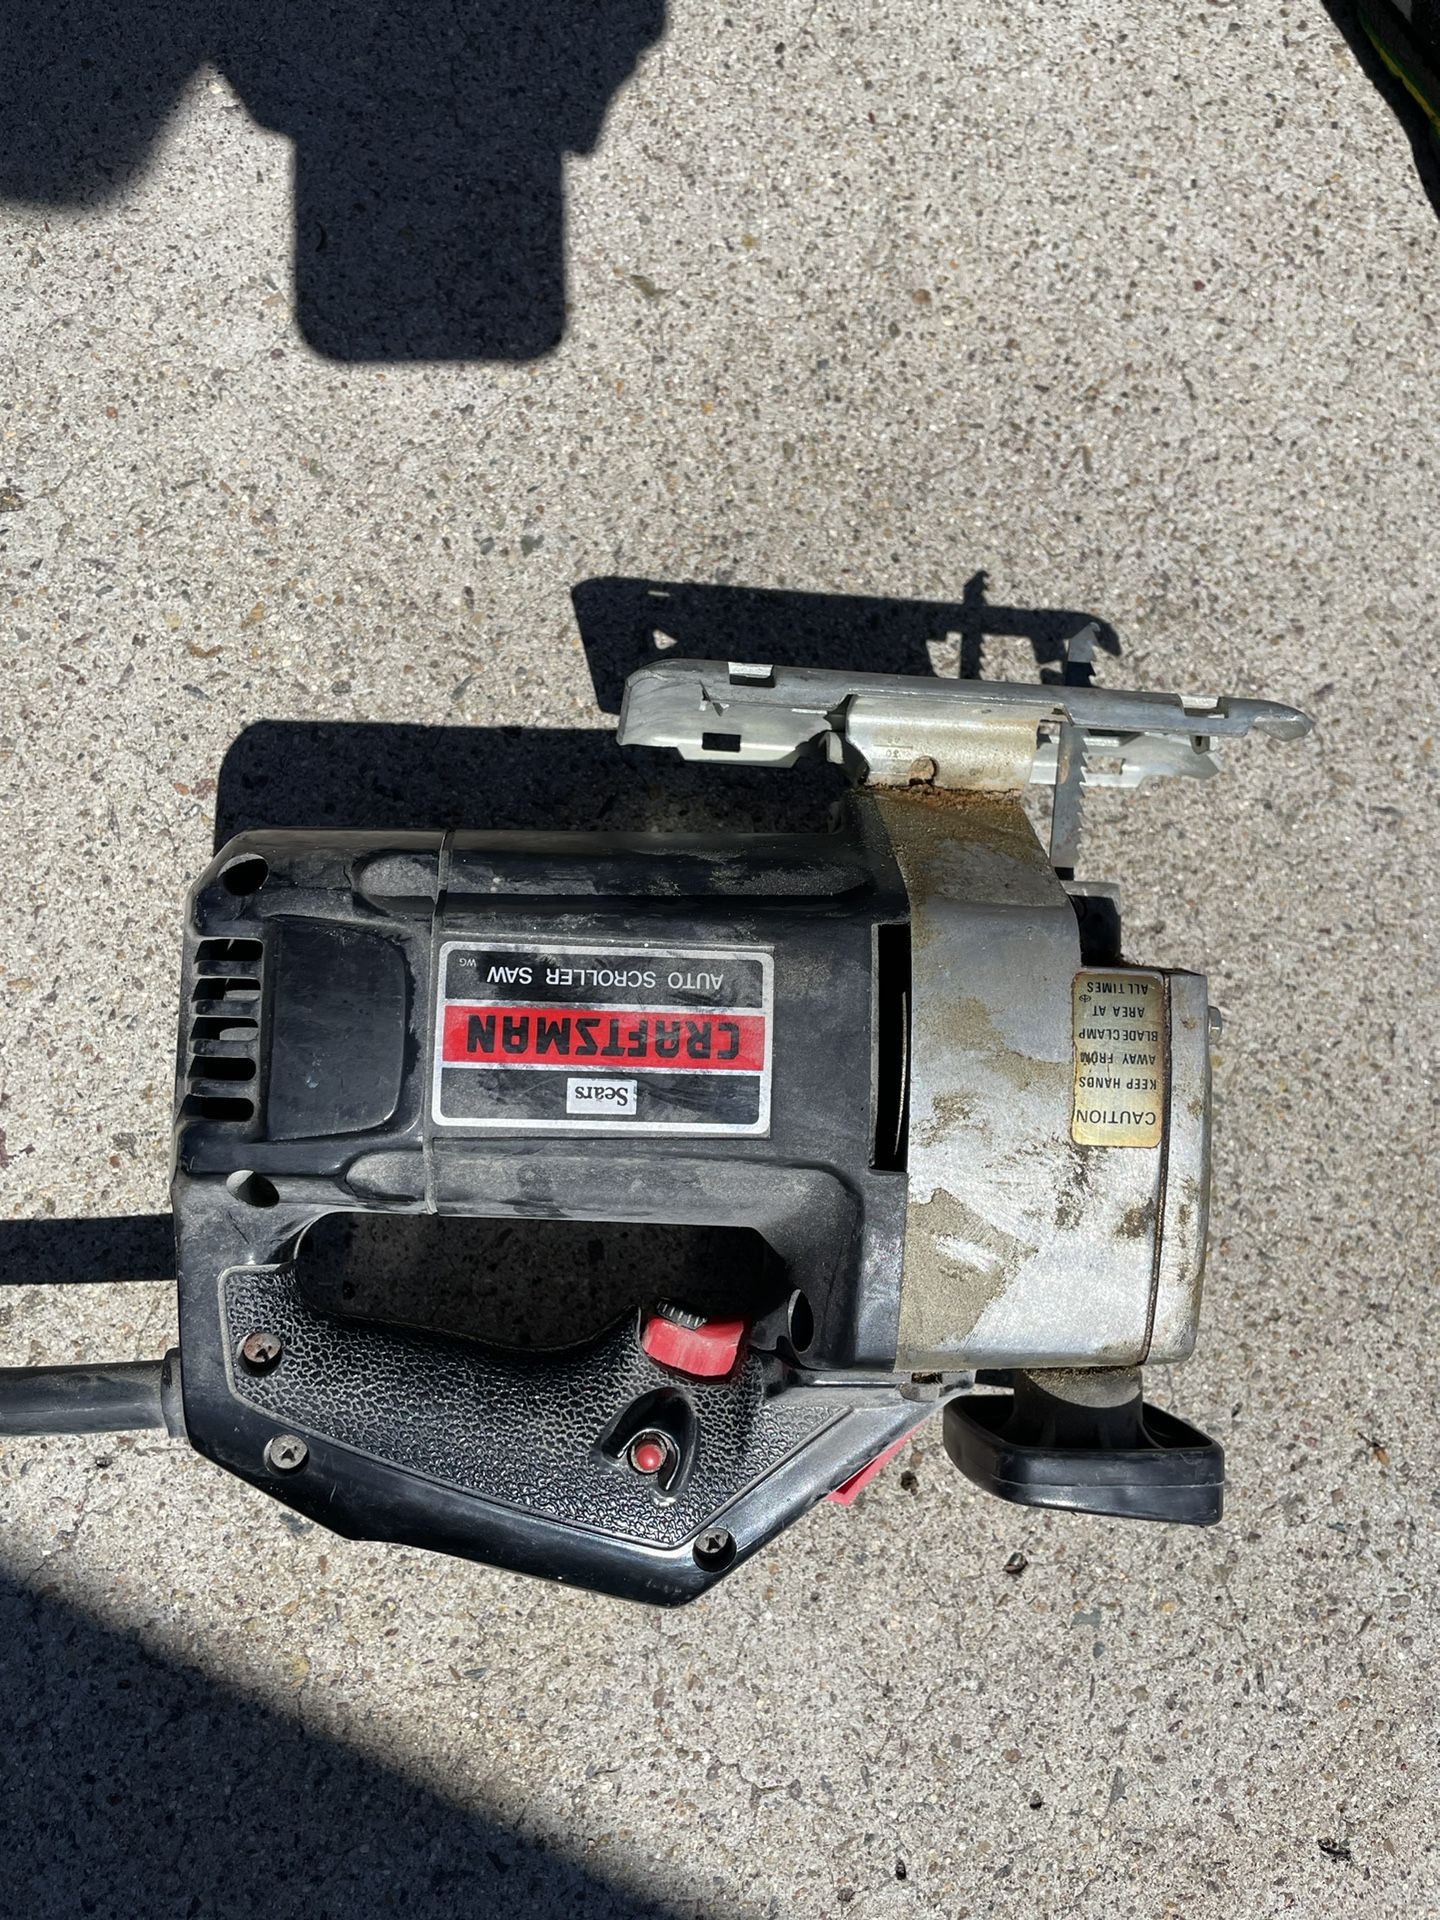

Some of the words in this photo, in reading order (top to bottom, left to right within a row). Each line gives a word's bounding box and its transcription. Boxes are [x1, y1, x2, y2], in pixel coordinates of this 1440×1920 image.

[459, 958, 476, 967] WG
[486, 966, 532, 985] SAW
[546, 968, 656, 987] SCROLLER
[668, 972, 724, 989] AUTO
[1092, 1006, 1106, 1017] AT
[1113, 1006, 1145, 1018] AREA
[467, 1014, 740, 1059] CRAFTSMAN
[1080, 1052, 1114, 1065] FROM
[1122, 1054, 1156, 1065] AWAY
[1126, 1078, 1157, 1090] KEEP
[575, 1086, 628, 1106] Sears
[1076, 1109, 1156, 1125] CAUTION
